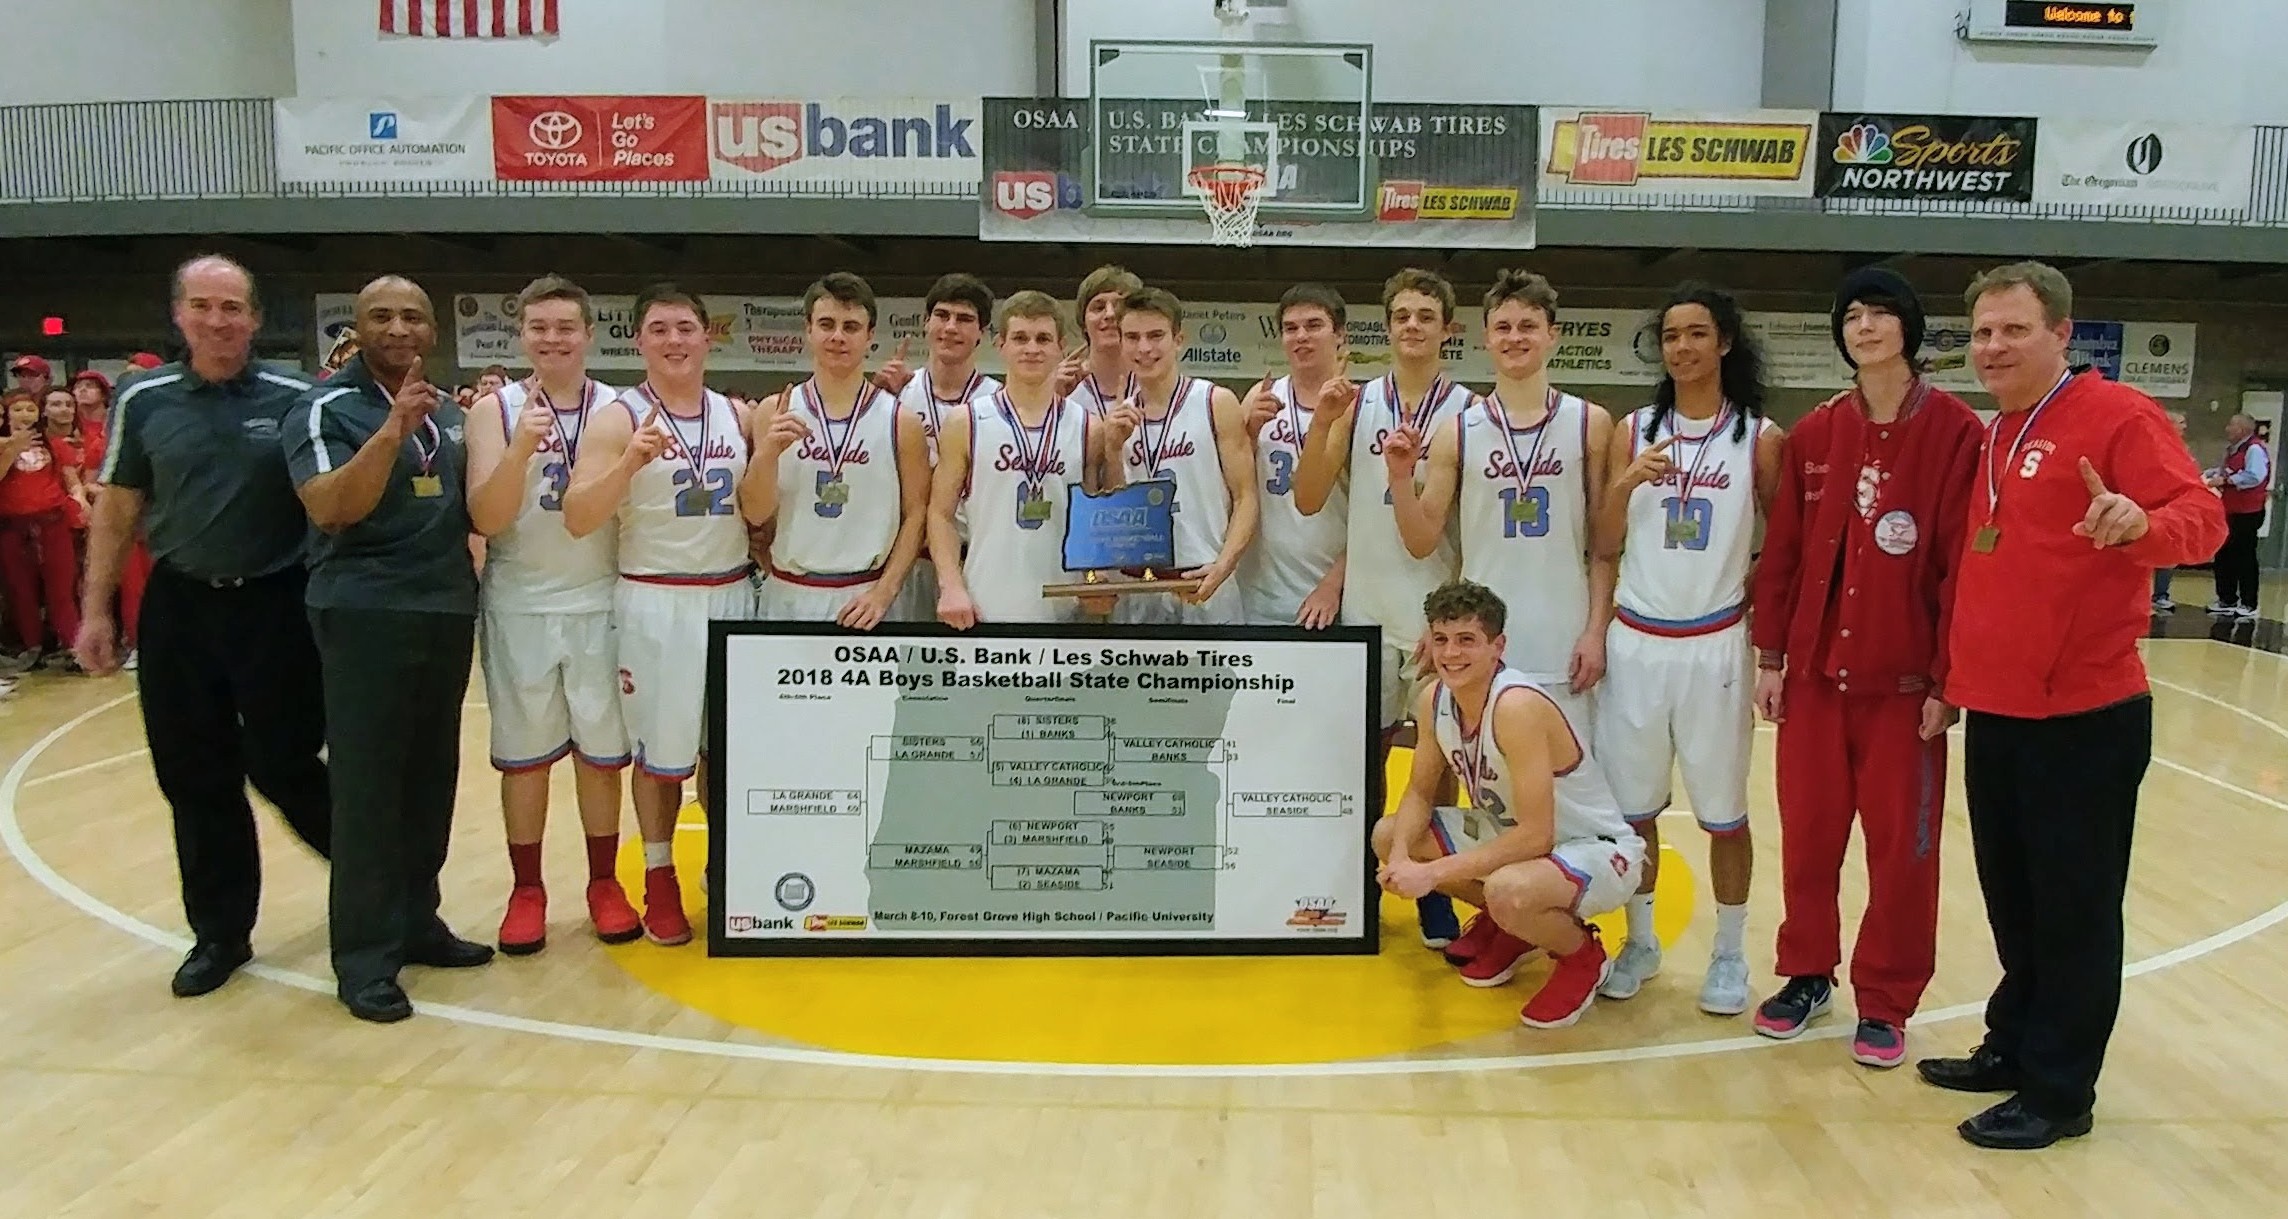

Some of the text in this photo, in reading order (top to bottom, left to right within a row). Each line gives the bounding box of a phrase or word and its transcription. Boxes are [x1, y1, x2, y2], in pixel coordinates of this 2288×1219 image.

[2044, 7, 2101, 22] Welcome
[2107, 9, 2123, 24] to
[611, 112, 655, 131] Let's
[1013, 109, 1079, 130] OSAA
[1108, 110, 1152, 130] U.S.
[1315, 112, 1422, 134] SCHWAB
[1430, 115, 1508, 136] TIRES
[612, 131, 638, 149] Go
[1580, 124, 1641, 165] Tires
[305, 143, 466, 155] PACIFIC OFFICE AUTOMATION
[1197, 135, 1416, 160] CAMPIONSHIPS
[1646, 137, 1797, 165] LES SCHWAB
[1889, 124, 2020, 170] Sports
[524, 152, 587, 168] TOYOTA
[612, 149, 674, 168] Places
[1842, 167, 2012, 193] NORTHWEST
[1382, 186, 1420, 213] Tires
[1423, 195, 1511, 211] LES SCHWAB
[609, 325, 635, 339] GU
[748, 335, 803, 344] PHYSICAL
[600, 347, 642, 356] WRESTL
[750, 345, 803, 355] THERAPY
[1556, 345, 1603, 357] ACTION
[1180, 347, 1242, 364] Allstate
[1546, 359, 1612, 370] ATHLETICS
[2125, 362, 2189, 375] CLEMENS
[2019, 449, 2044, 480] S
[673, 467, 735, 518] 22
[834, 645, 1254, 669] OSAA / U.S. Bank / Les Schwab Tires
[777, 668, 1296, 694] 2018 4A Boys Basketball State Championship
[1036, 716, 1079, 725] SISTERS
[1040, 730, 1075, 739] BANKS
[901, 737, 946, 746] SISTERS
[1122, 739, 1163, 748] VALLEY
[1164, 740, 1216, 748] CATHOLIC
[895, 751, 912, 759] LA
[913, 751, 955, 759] GRANDE
[1151, 753, 1187, 761] BANKS
[1010, 762, 1051, 771] VALLEY
[1052, 762, 1103, 771] CATHOLIC
[1028, 777, 1041, 785] LA
[1043, 777, 1087, 786] GRANDE
[773, 791, 787, 800] LA
[789, 791, 834, 800] GRANDE
[1102, 792, 1154, 801] NEWPORT
[1241, 793, 1280, 803] VALLEY
[1282, 794, 1332, 803] CATHOLIC
[770, 804, 837, 814] MARSHFIELD
[1110, 805, 1146, 815] BANKS
[1266, 807, 1309, 816] SEASIDE
[1027, 821, 1079, 831] NEWPORT
[1022, 835, 1089, 844] MARSHFIELD
[904, 846, 950, 855] MAZAMA
[1143, 847, 1196, 856] NEWPORT
[894, 858, 961, 868] MARSHFIELD
[1147, 859, 1191, 869] SEASIDE
[1035, 867, 1080, 876] MAZAMA
[1037, 881, 1080, 890] SEASIDE
[874, 910, 908, 922] March
[940, 911, 979, 923] Forest
[983, 911, 1019, 923] Grove
[1022, 912, 1051, 925] High
[1054, 911, 1097, 923] School
[1107, 911, 1149, 923] Pacific
[1152, 911, 1215, 925] University
